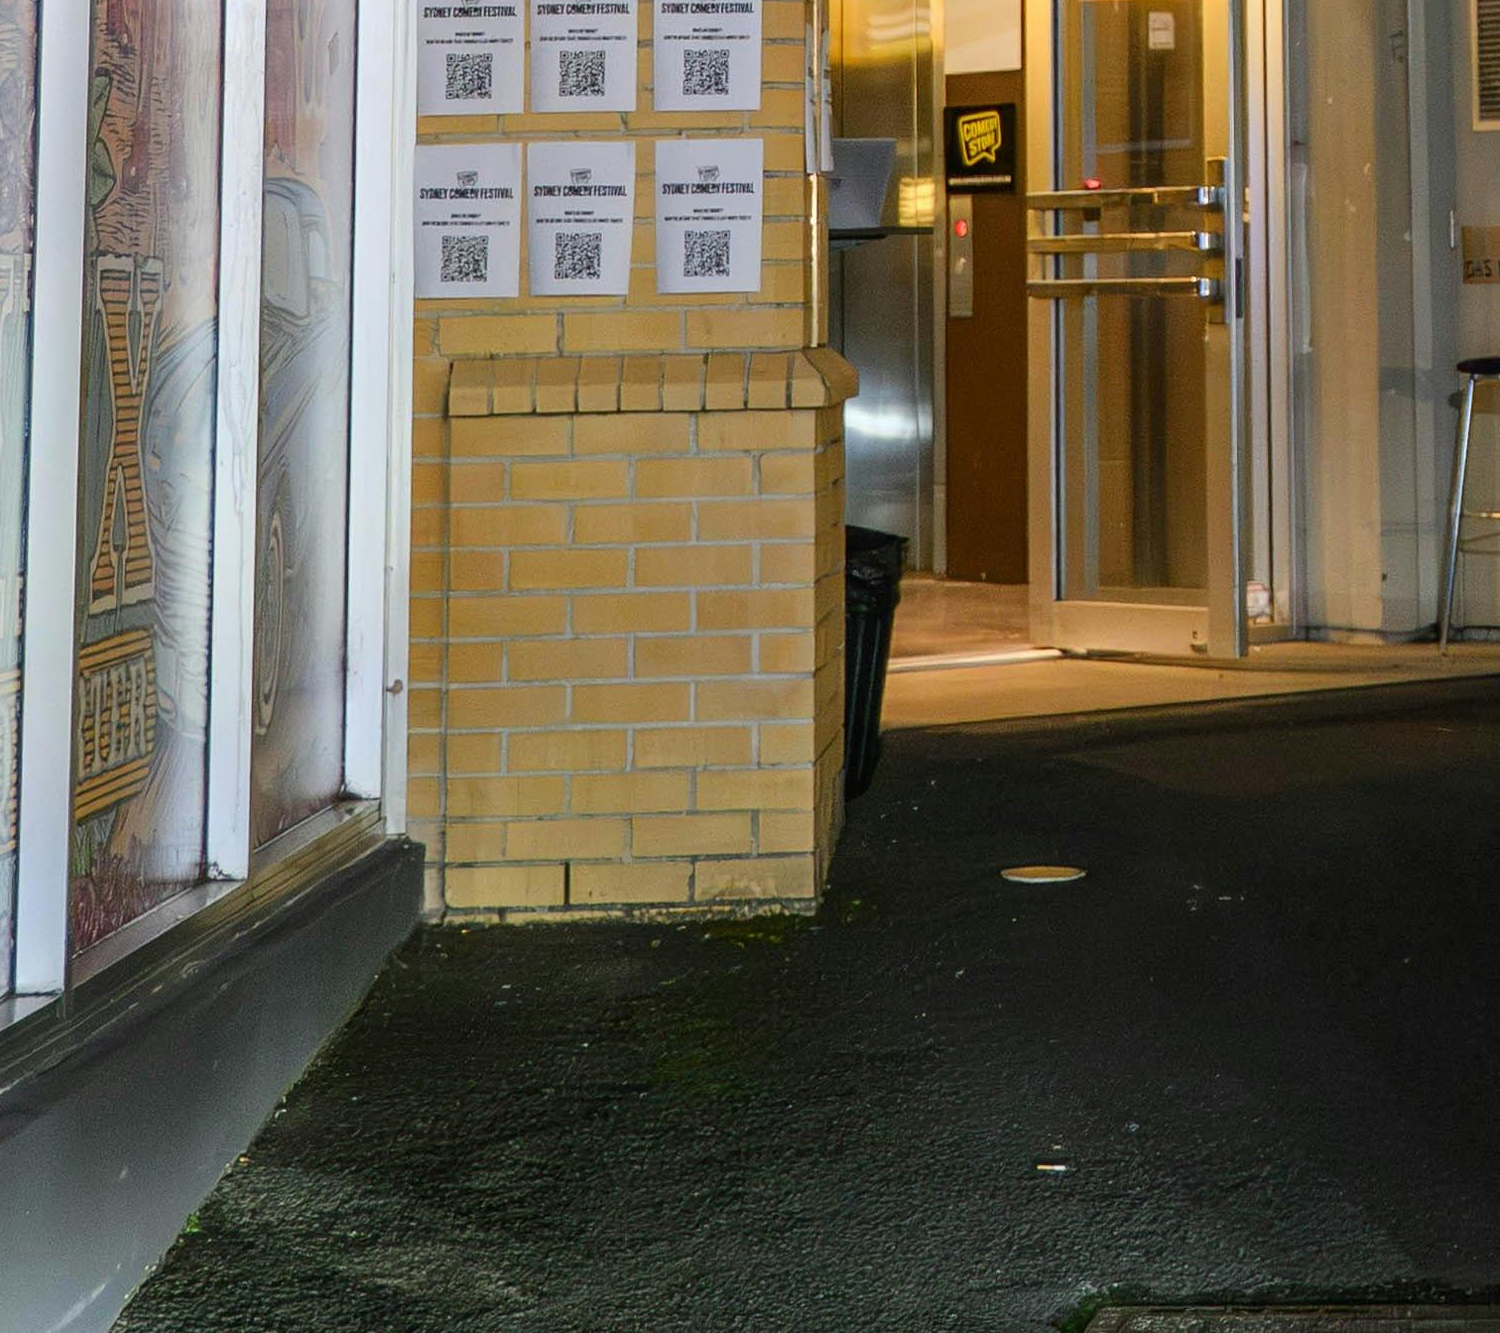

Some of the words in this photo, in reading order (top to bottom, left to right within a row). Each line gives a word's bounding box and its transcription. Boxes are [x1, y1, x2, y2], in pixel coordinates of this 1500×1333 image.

[423, 6, 451, 19] SYDNEY
[483, 6, 517, 18] FESTIVAL
[537, 4, 565, 16] SYDNEY
[596, 3, 631, 15] FESTIVAL
[661, 3, 689, 15] SYDNEY
[721, 2, 755, 14] FESTIVAL
[420, 187, 449, 200] SYDNEY
[480, 187, 514, 199] FESTIVAL
[533, 185, 562, 198] SYDNEY
[594, 184, 628, 197] FESTIVAL
[662, 182, 690, 195] SYDNEY
[721, 181, 755, 194] FESTIVAL
